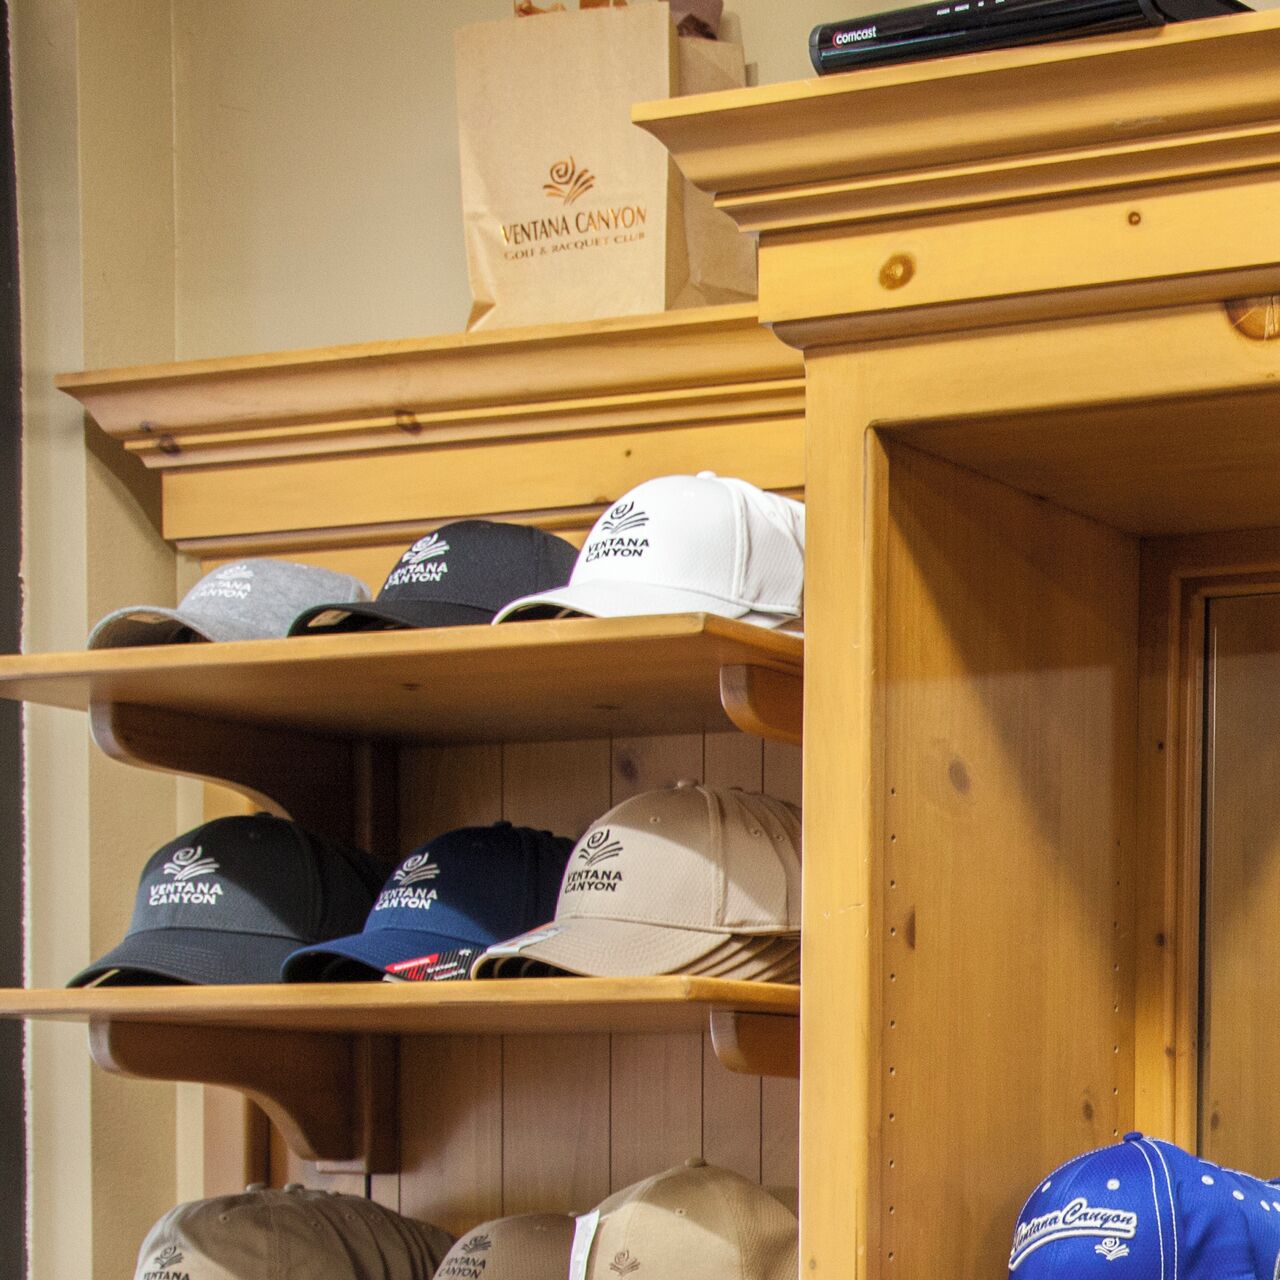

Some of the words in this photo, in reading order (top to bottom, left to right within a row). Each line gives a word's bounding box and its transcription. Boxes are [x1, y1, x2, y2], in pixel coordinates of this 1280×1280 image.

[834, 26, 877, 46] comcast
[500, 215, 571, 245] VENTANA
[575, 206, 646, 233] CANYON
[588, 537, 650, 552] VENTANA
[586, 549, 643, 563] CANYON
[567, 869, 623, 883] VENTANA
[150, 881, 223, 897] VENTANA
[378, 886, 438, 901] VENTANA
[565, 880, 618, 894] CANYON
[149, 893, 217, 906] CANYON
[375, 897, 431, 911] CANYON
[1061, 1199, 1135, 1229] Canyon
